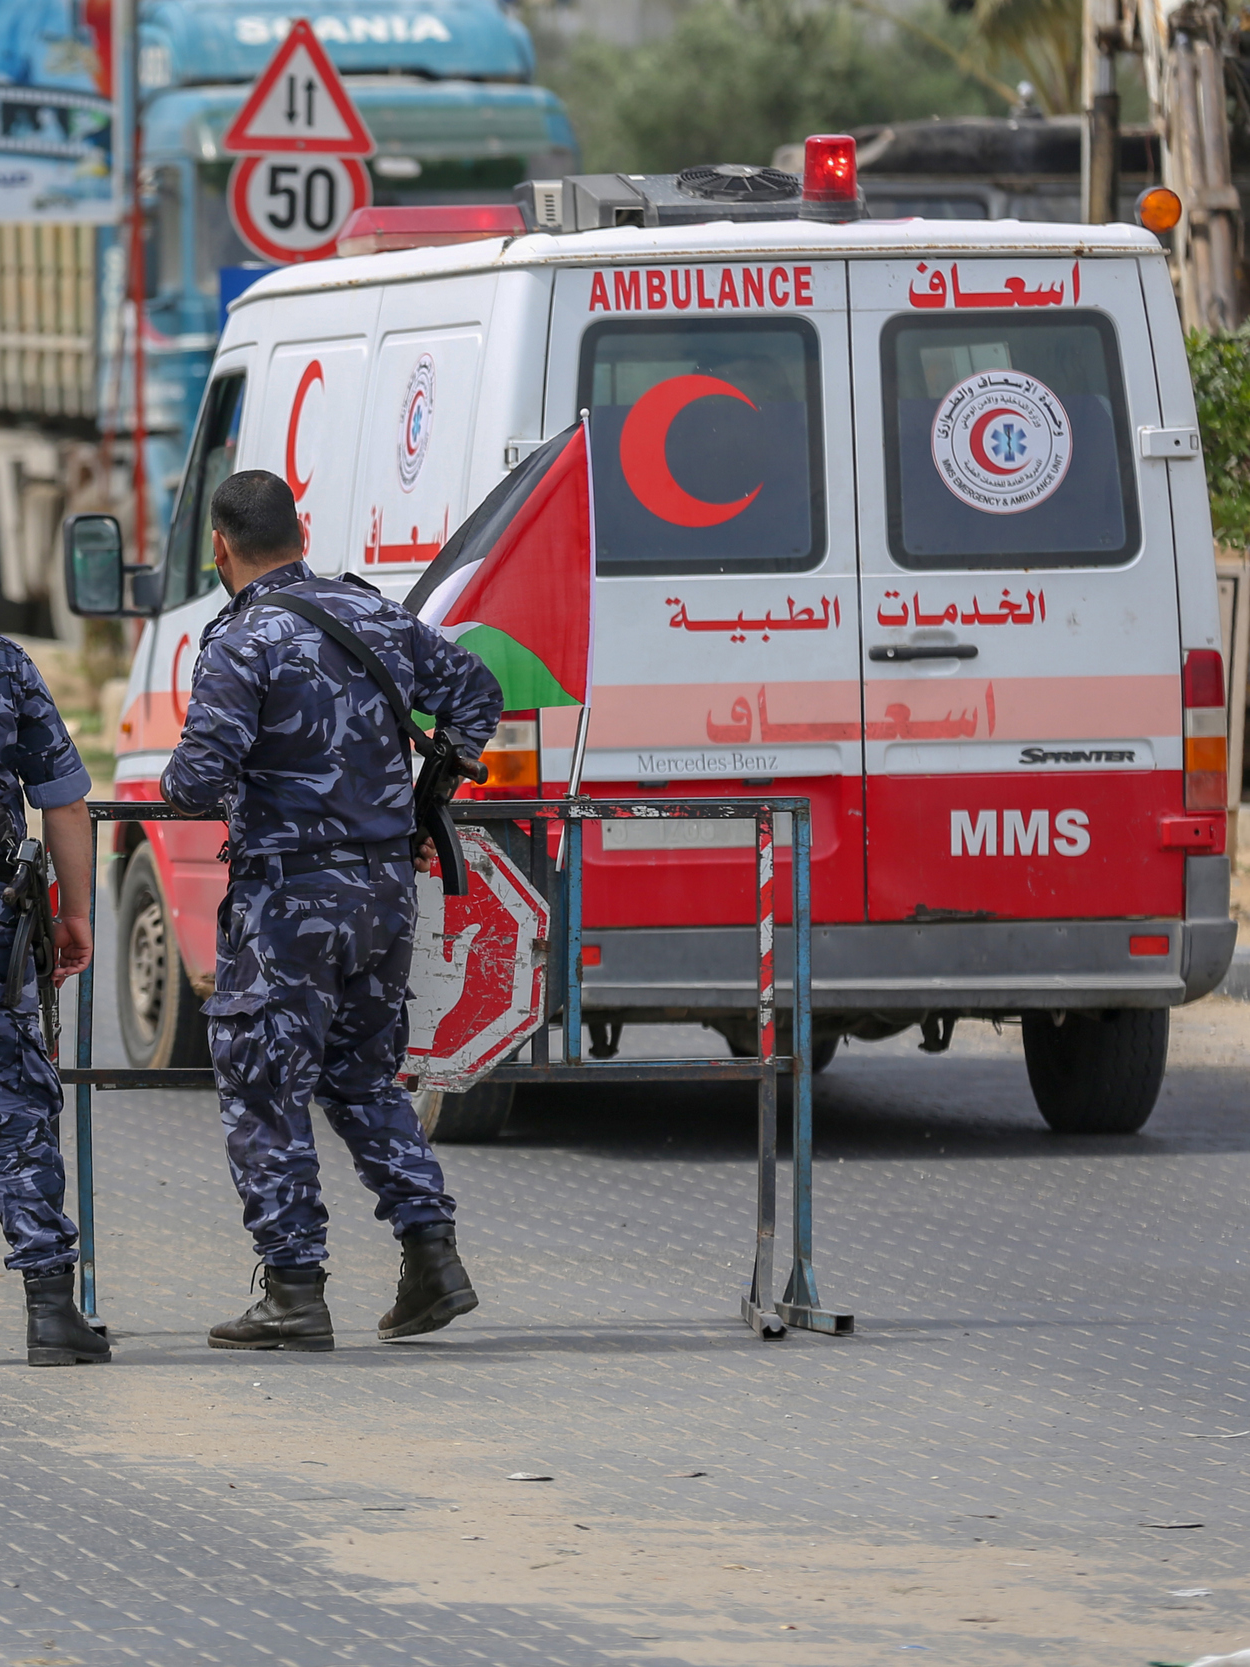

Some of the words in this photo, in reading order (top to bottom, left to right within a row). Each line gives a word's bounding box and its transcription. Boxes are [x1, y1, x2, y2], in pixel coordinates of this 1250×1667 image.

[267, 166, 336, 232] 50
[589, 266, 814, 311] AMBULANCE
[909, 259, 1081, 309] اسعاف
[941, 458, 956, 479] MMS
[953, 475, 1001, 506] EMERGENCY
[1002, 498, 1009, 507] &
[1010, 474, 1056, 506] AMBULANCE
[1051, 453, 1064, 474] UNIT
[665, 594, 841, 644] الطبية
[877, 588, 1047, 627] الخدمات
[637, 752, 779, 774] Mercedes-Benz
[950, 809, 1091, 857] MMS
